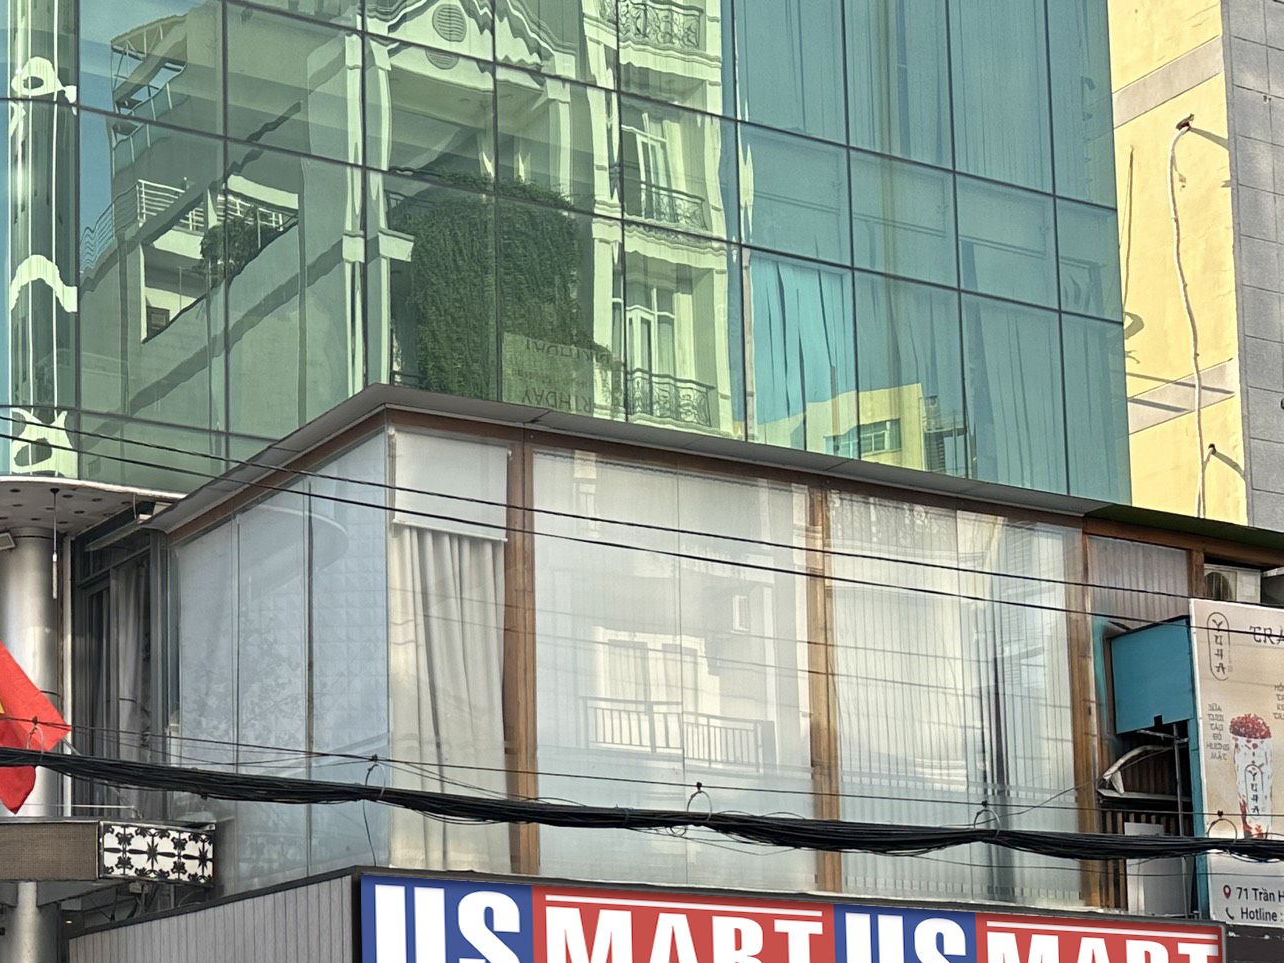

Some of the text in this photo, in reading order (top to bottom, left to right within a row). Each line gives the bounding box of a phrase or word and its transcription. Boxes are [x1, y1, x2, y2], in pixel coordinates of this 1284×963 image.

[1236, 887, 1248, 900] 71
[1252, 887, 1275, 902] Trần
[1241, 907, 1277, 922] Hotline
